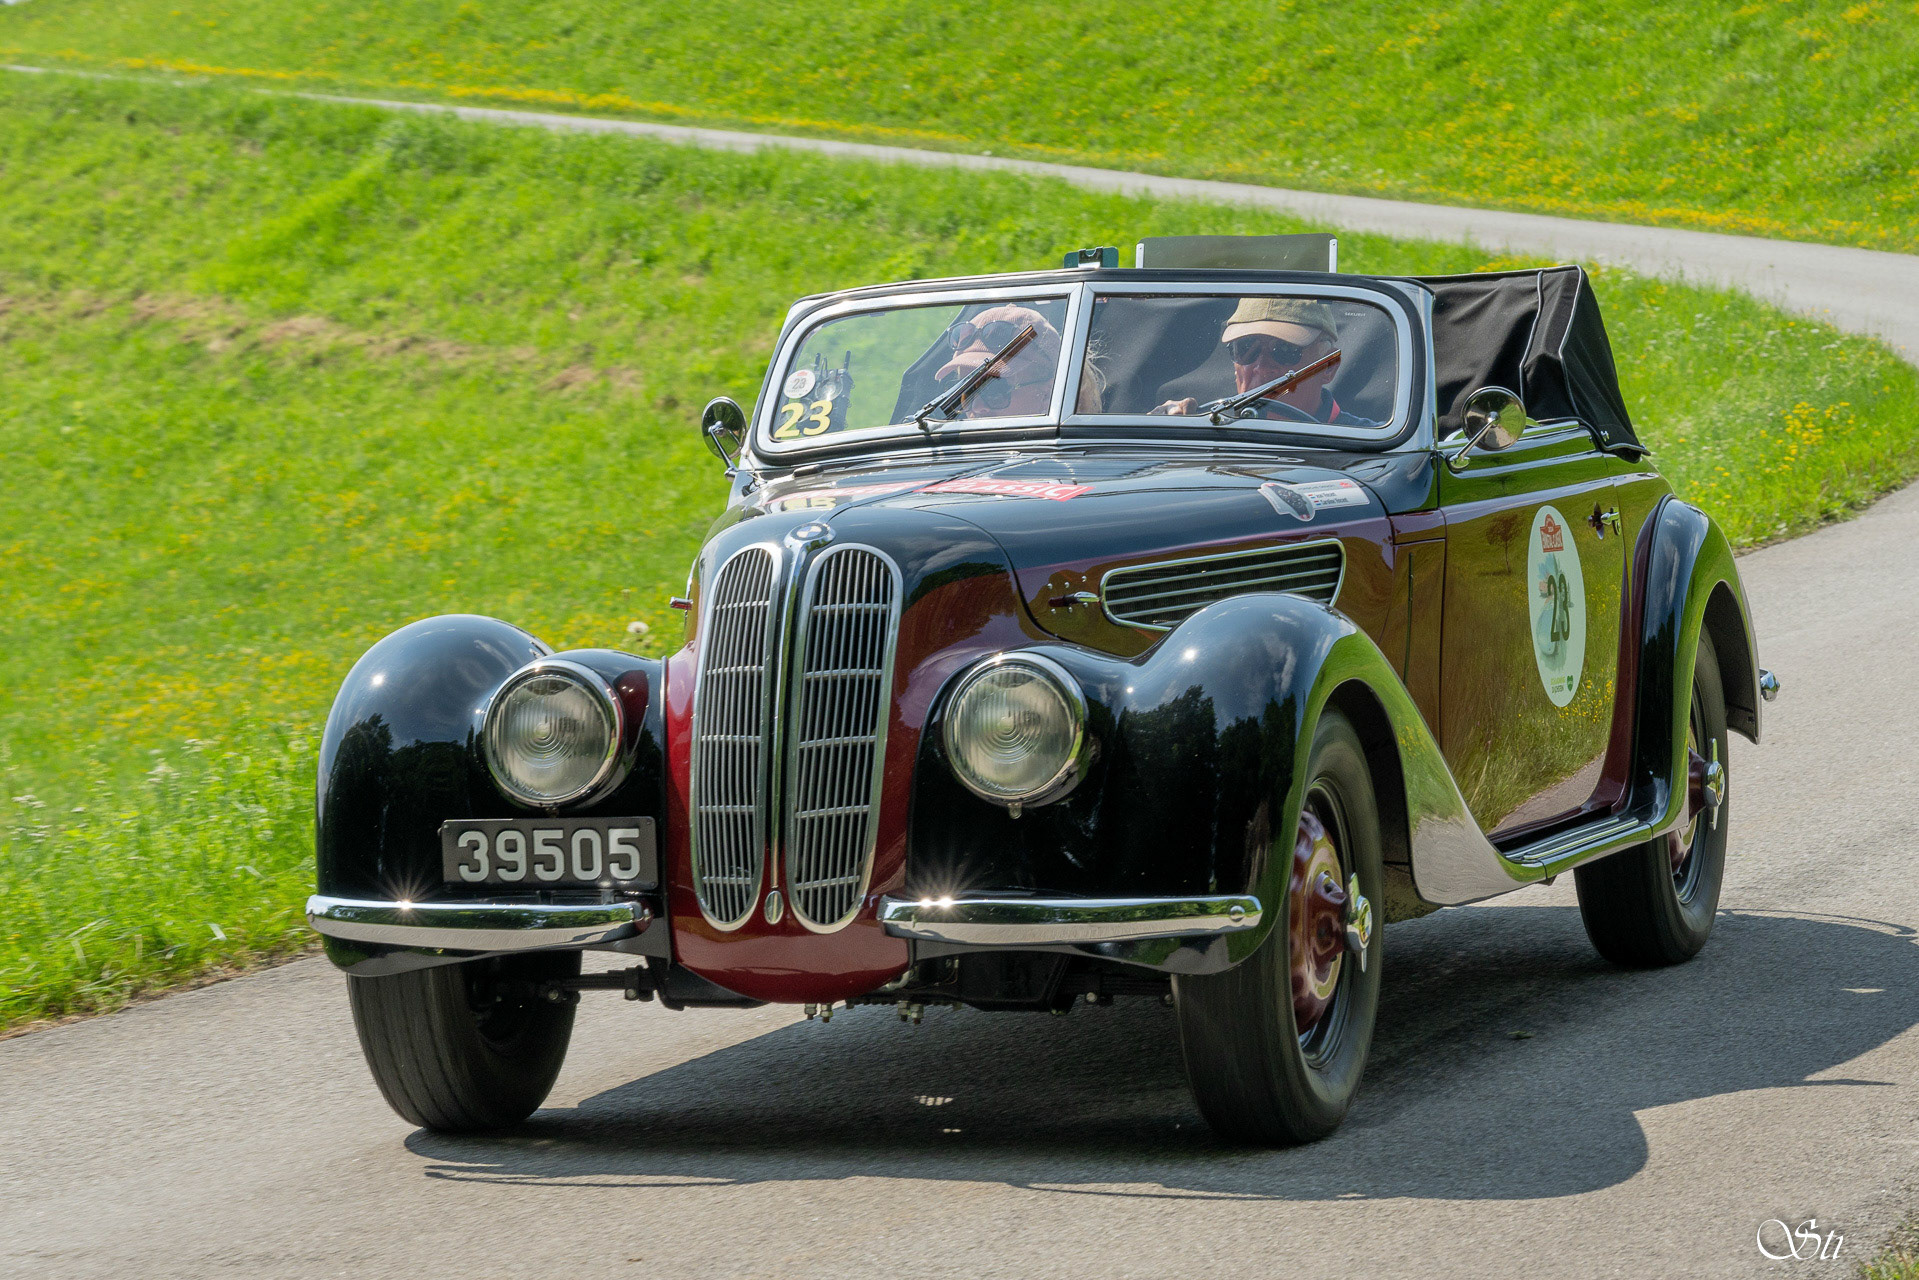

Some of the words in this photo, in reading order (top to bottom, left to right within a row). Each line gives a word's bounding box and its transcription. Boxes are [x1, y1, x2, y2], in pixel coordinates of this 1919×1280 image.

[792, 378, 806, 390] 23
[774, 400, 833, 438] 23
[1547, 573, 1570, 642] 23
[457, 828, 641, 882] 39505
